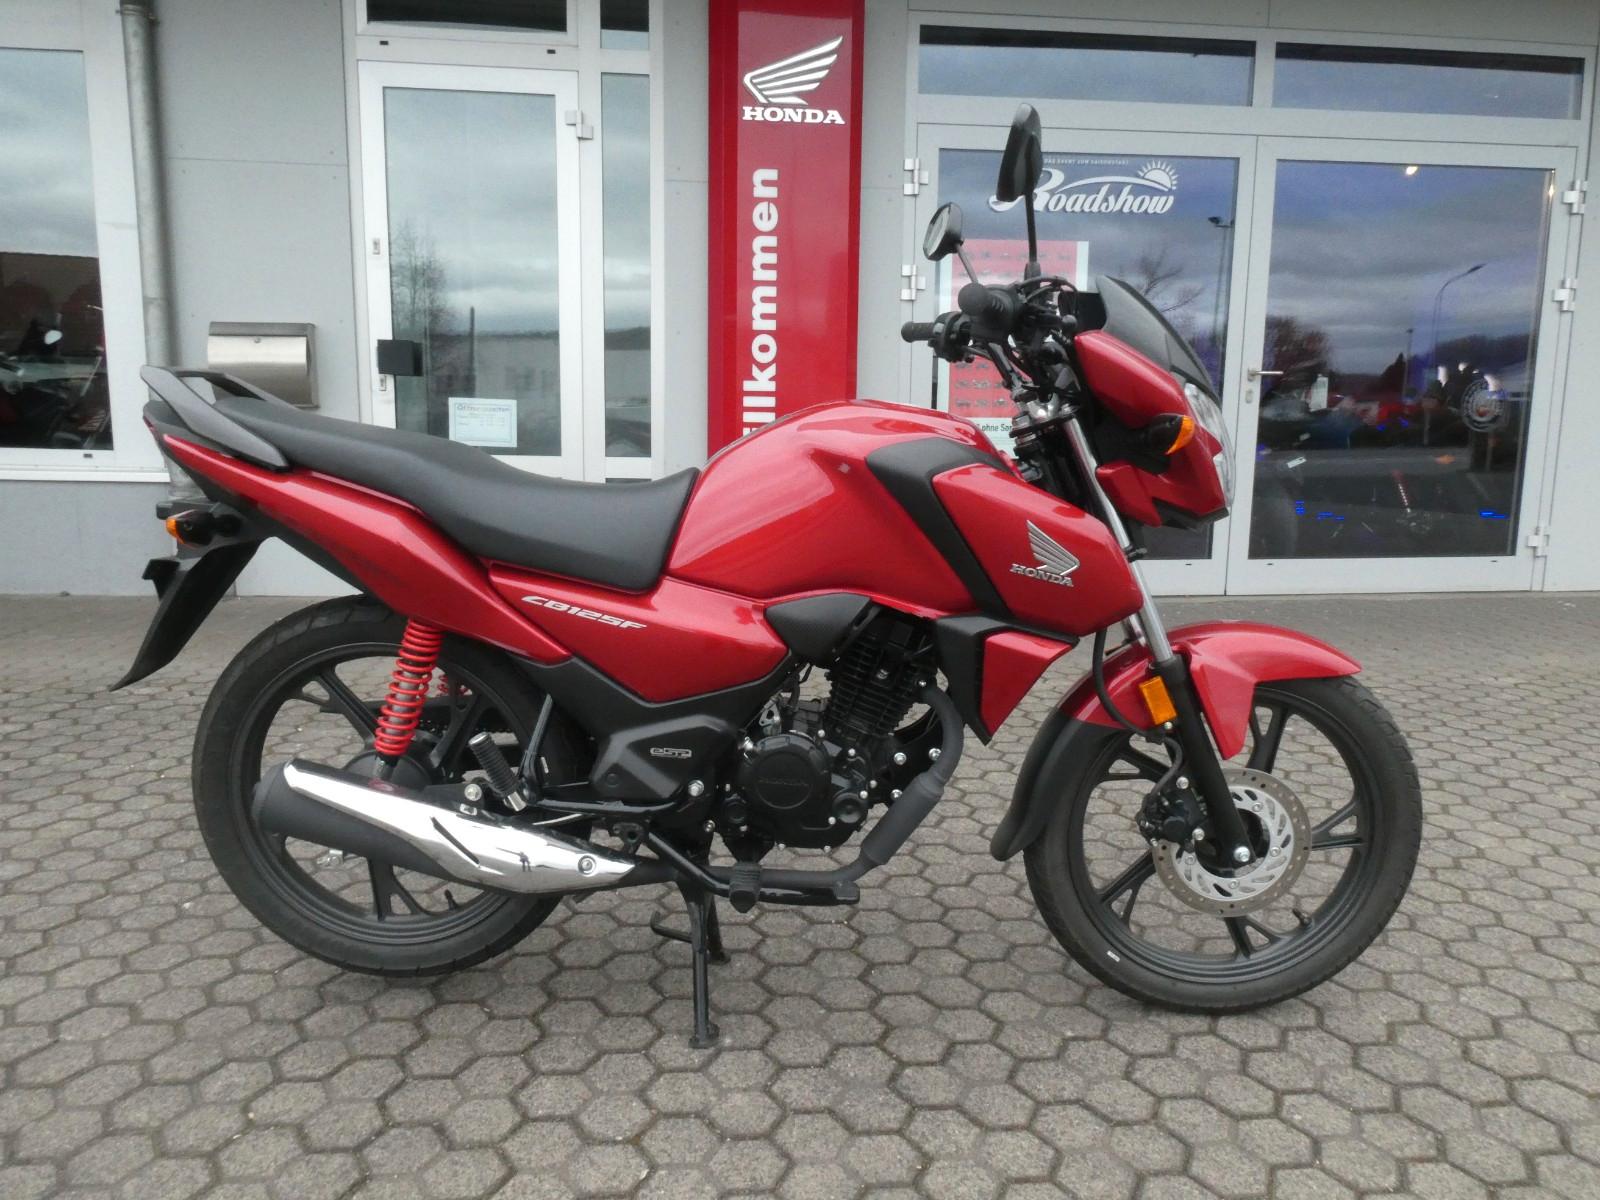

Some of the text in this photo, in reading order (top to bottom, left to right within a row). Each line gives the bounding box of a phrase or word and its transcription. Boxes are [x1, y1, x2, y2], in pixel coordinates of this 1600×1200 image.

[742, 106, 846, 125] HONDA
[989, 168, 1174, 214] Roadshow
[742, 168, 779, 437] llkommen
[1009, 563, 1074, 587] HONDA
[521, 595, 647, 629] CB125F
